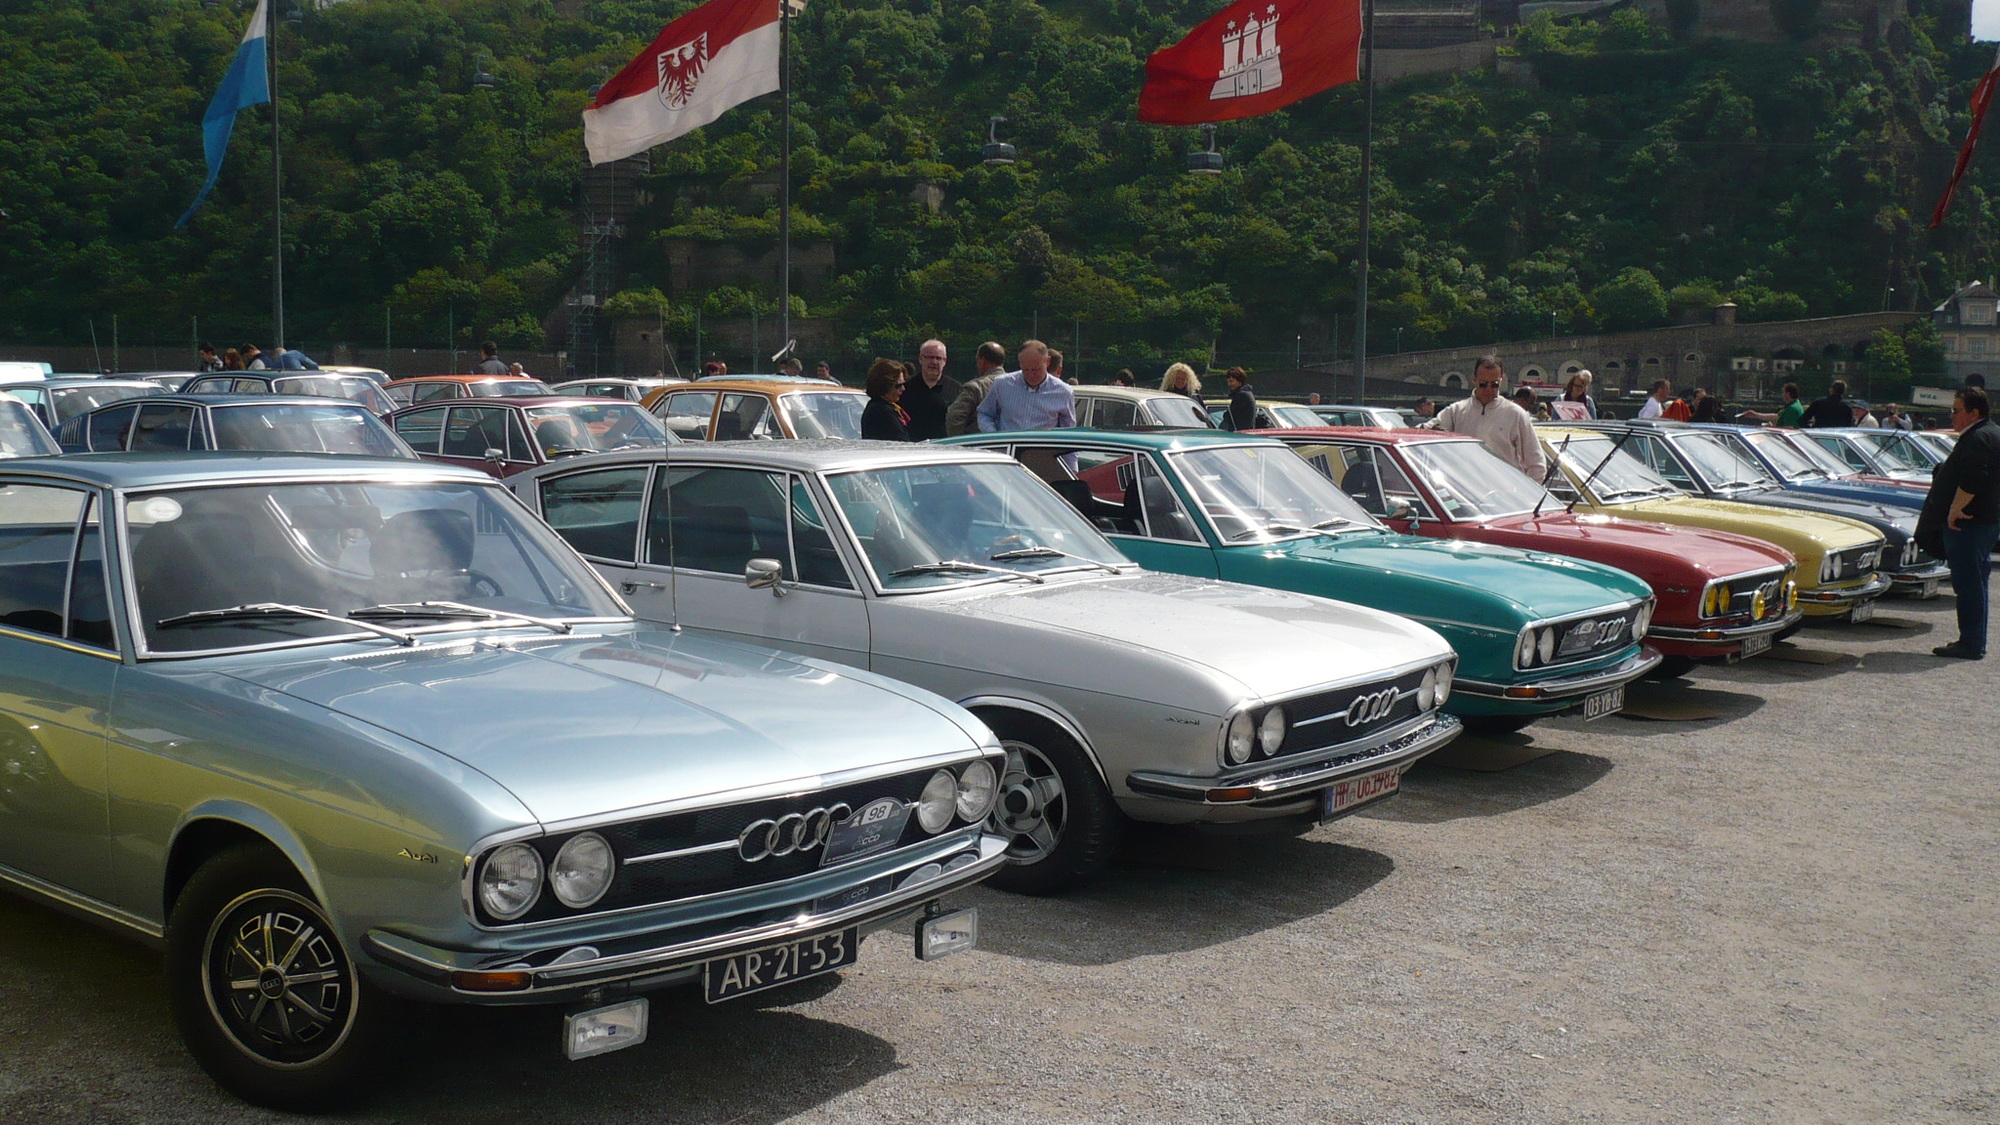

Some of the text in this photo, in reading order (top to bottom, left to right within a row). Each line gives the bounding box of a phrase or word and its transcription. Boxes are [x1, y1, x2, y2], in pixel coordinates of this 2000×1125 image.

[868, 805, 887, 821] 98
[398, 847, 438, 864] Audi
[719, 930, 845, 995] AR-21-53
